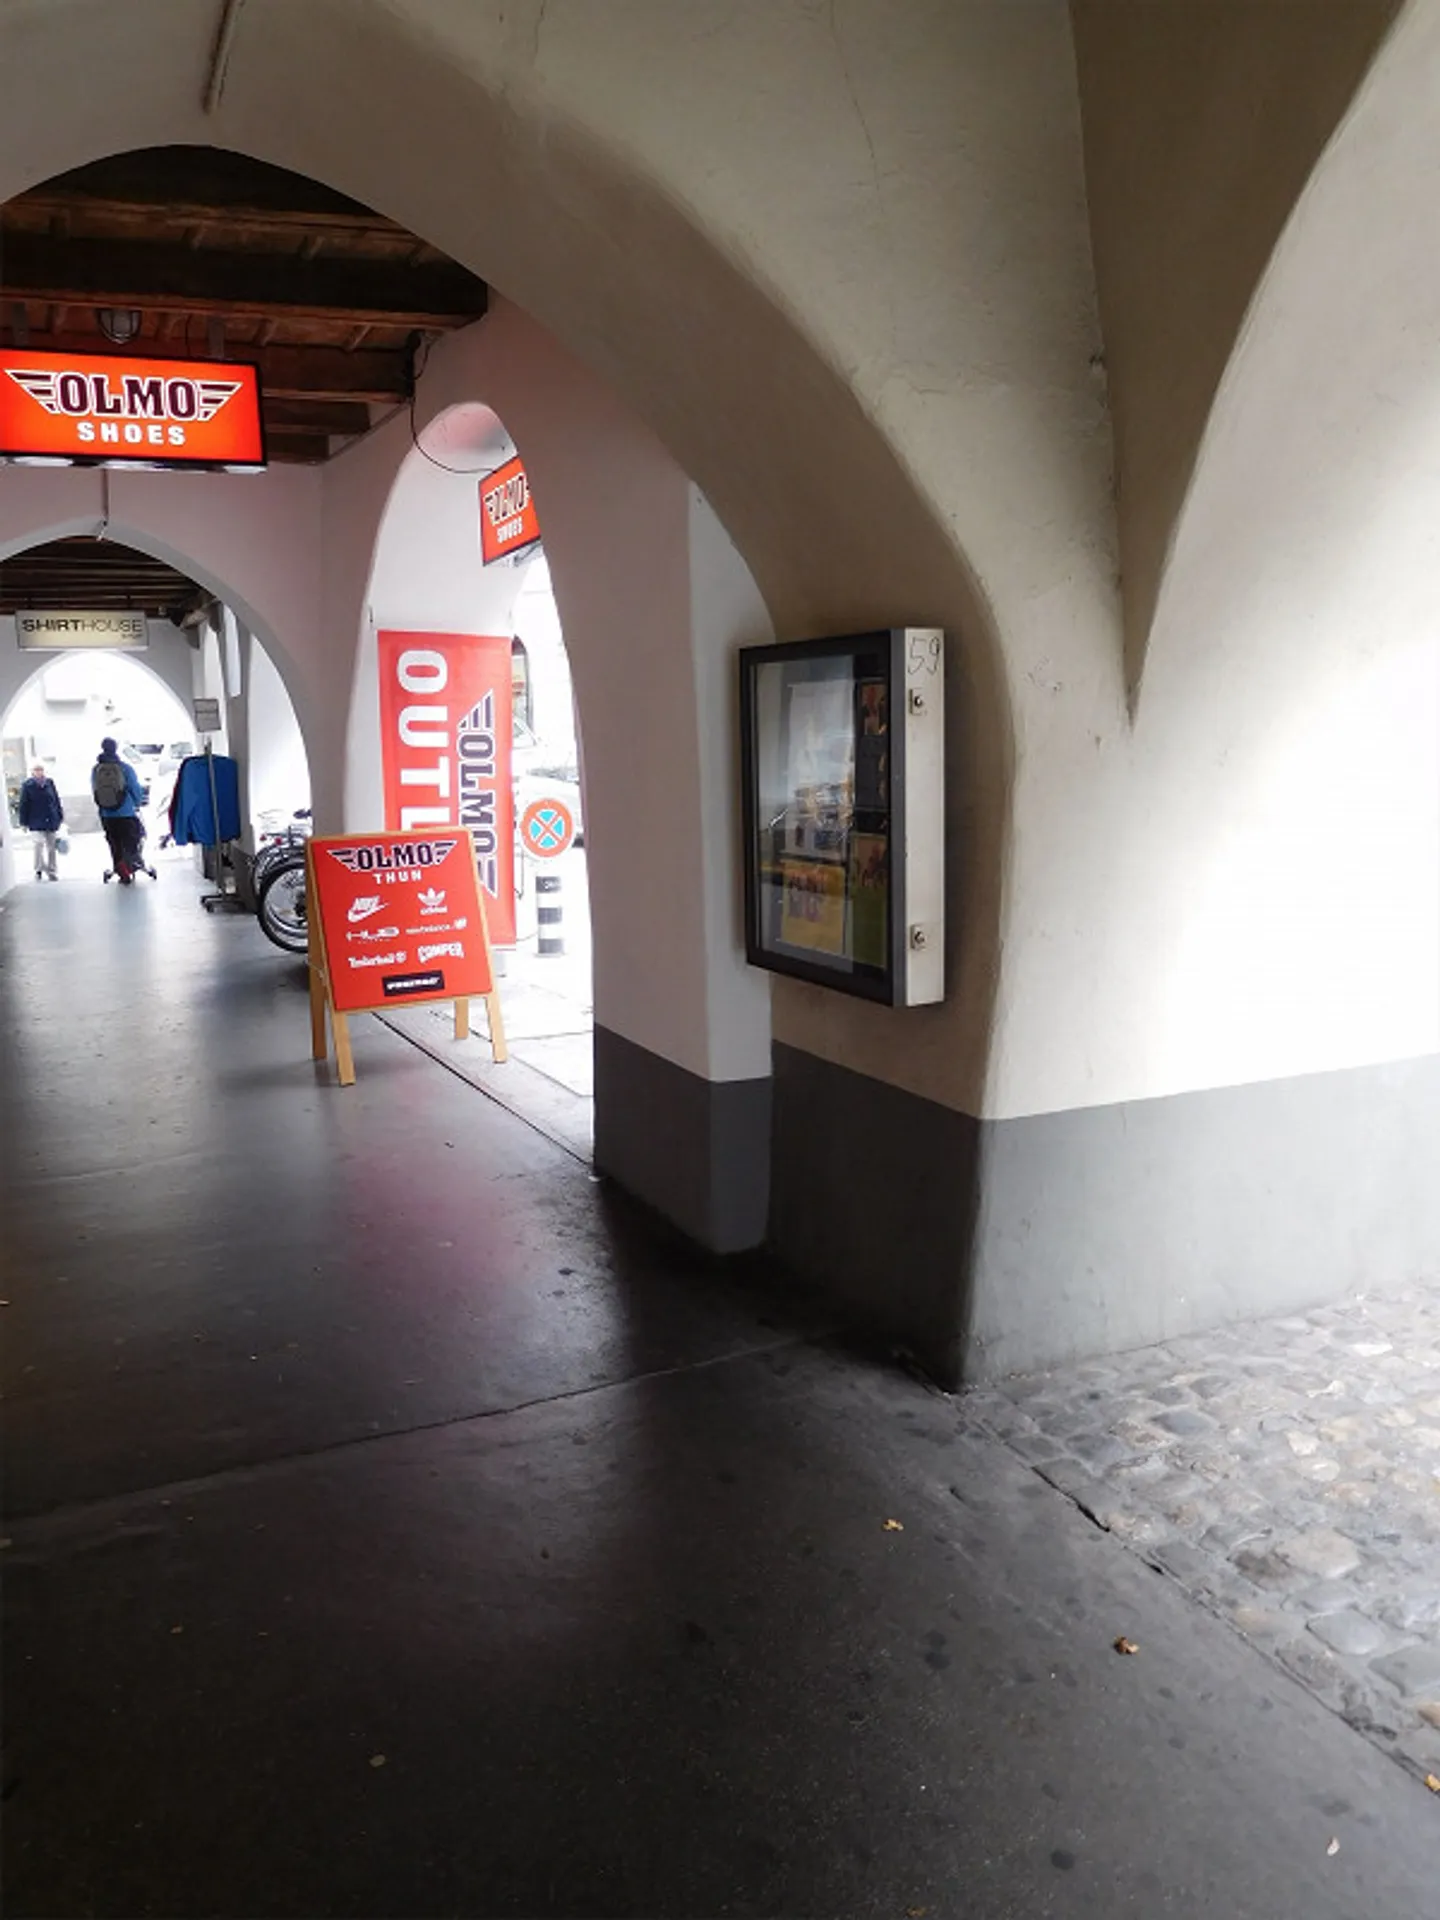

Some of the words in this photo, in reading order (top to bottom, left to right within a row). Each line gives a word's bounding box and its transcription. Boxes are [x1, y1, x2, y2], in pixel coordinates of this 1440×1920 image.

[56, 370, 199, 421] OLMO
[77, 422, 186, 446] SHOES
[907, 636, 942, 675] 59
[356, 842, 434, 872] OLMO
[374, 870, 422, 884] THUN
